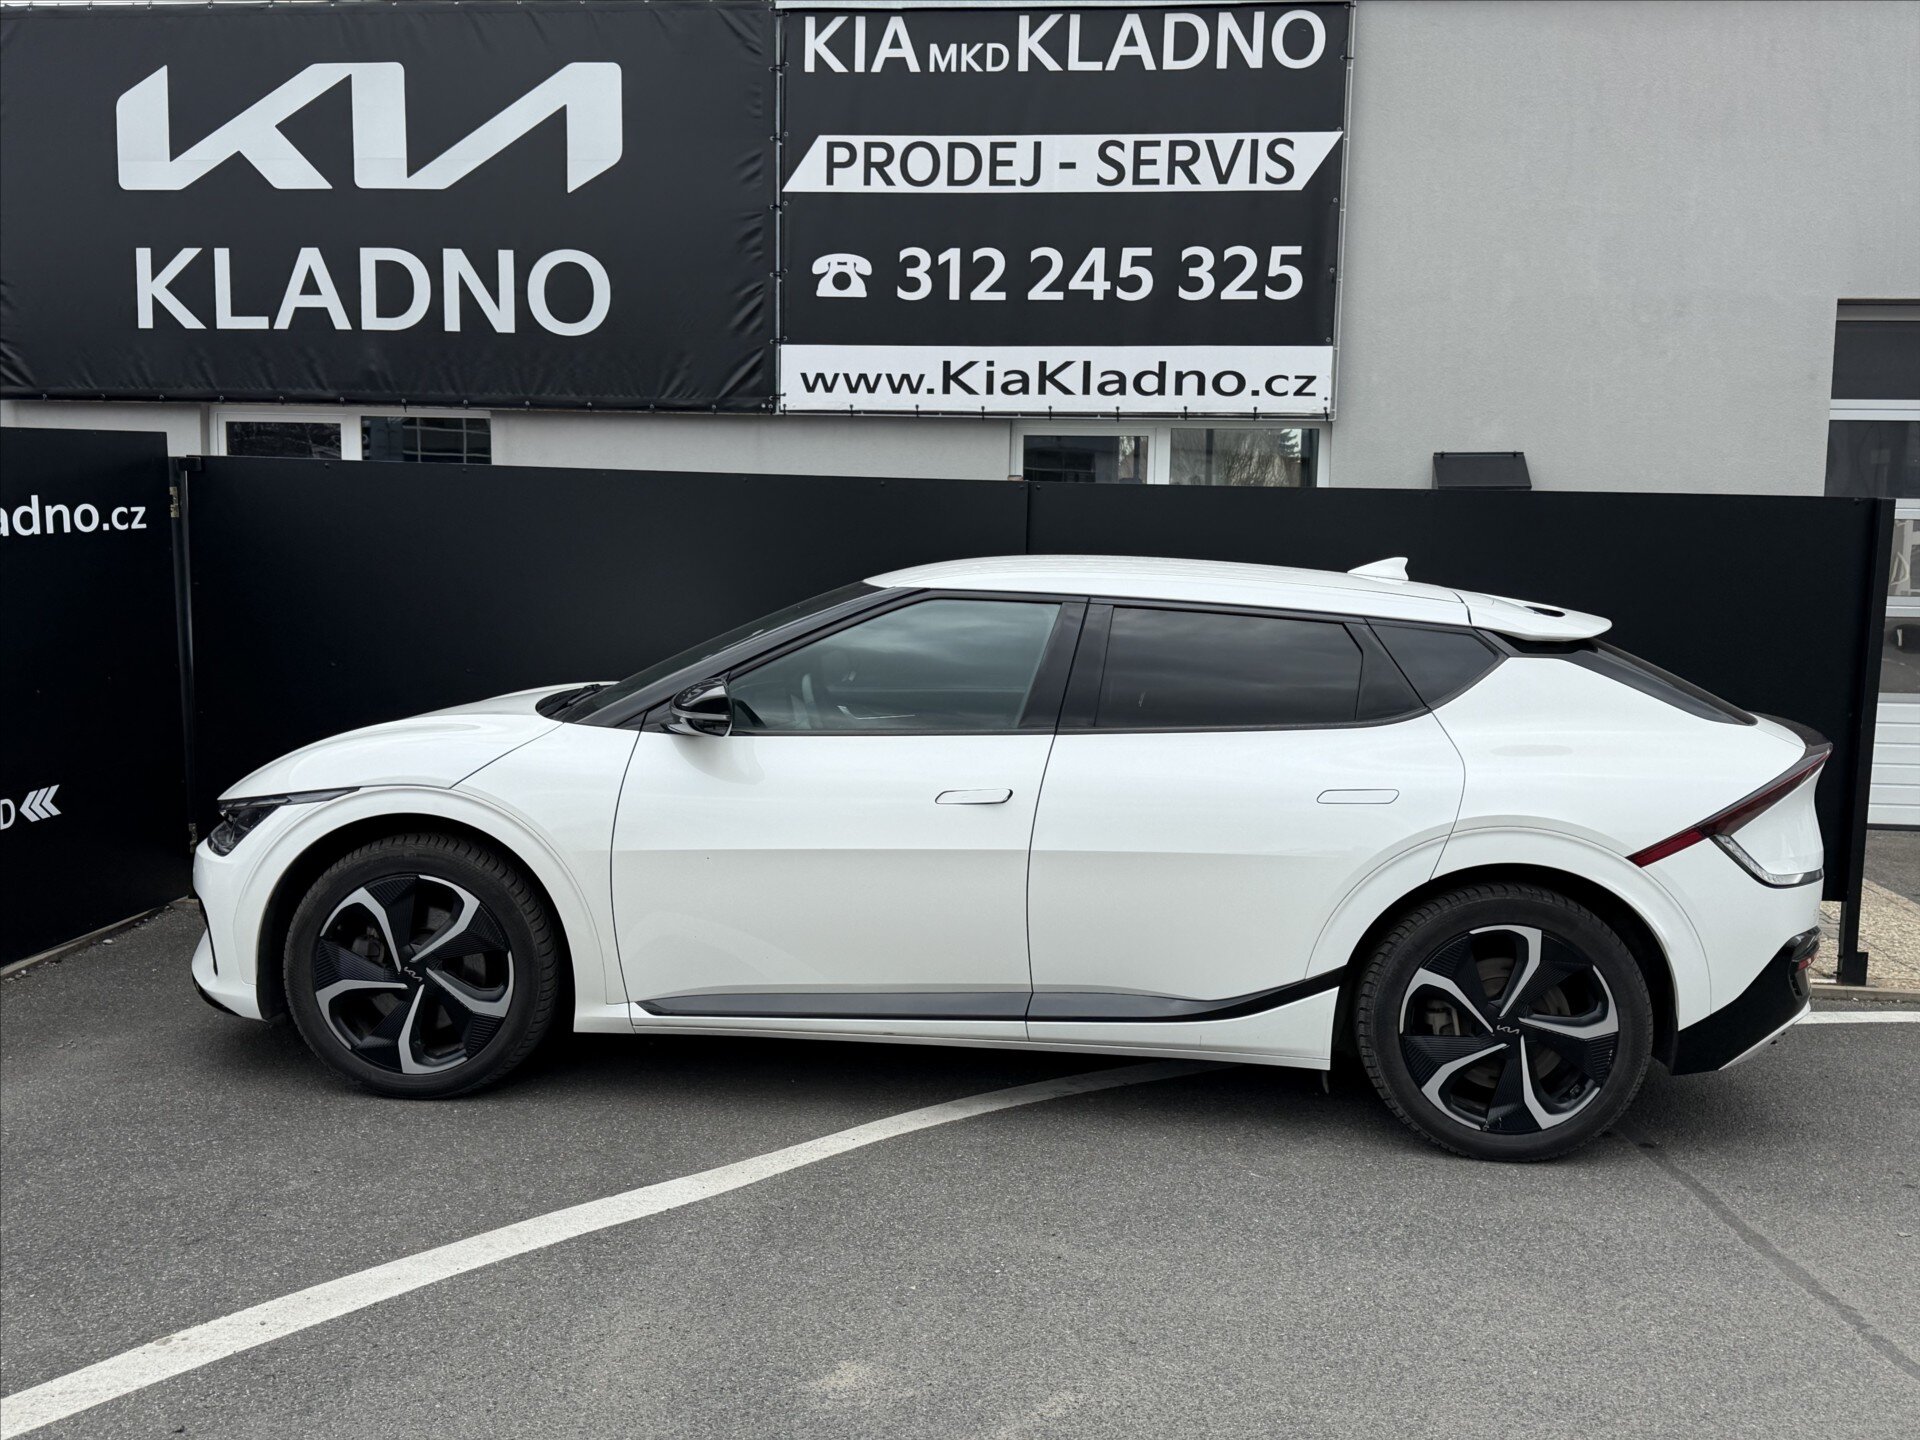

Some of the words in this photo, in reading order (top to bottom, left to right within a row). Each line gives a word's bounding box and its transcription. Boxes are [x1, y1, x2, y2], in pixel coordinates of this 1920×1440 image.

[804, 15, 922, 73] KIA
[928, 42, 1010, 73] MKD
[1017, 9, 1327, 72] KLADNO
[115, 61, 623, 194] KIA
[826, 140, 1042, 188] PRODEJ
[1096, 137, 1295, 187] SERVIS
[135, 247, 611, 337] KLADNO
[896, 246, 1007, 301] 312
[1027, 246, 1154, 302] 245
[1178, 245, 1304, 301] 325
[800, 360, 1317, 397] www.KiaKladno.cz
